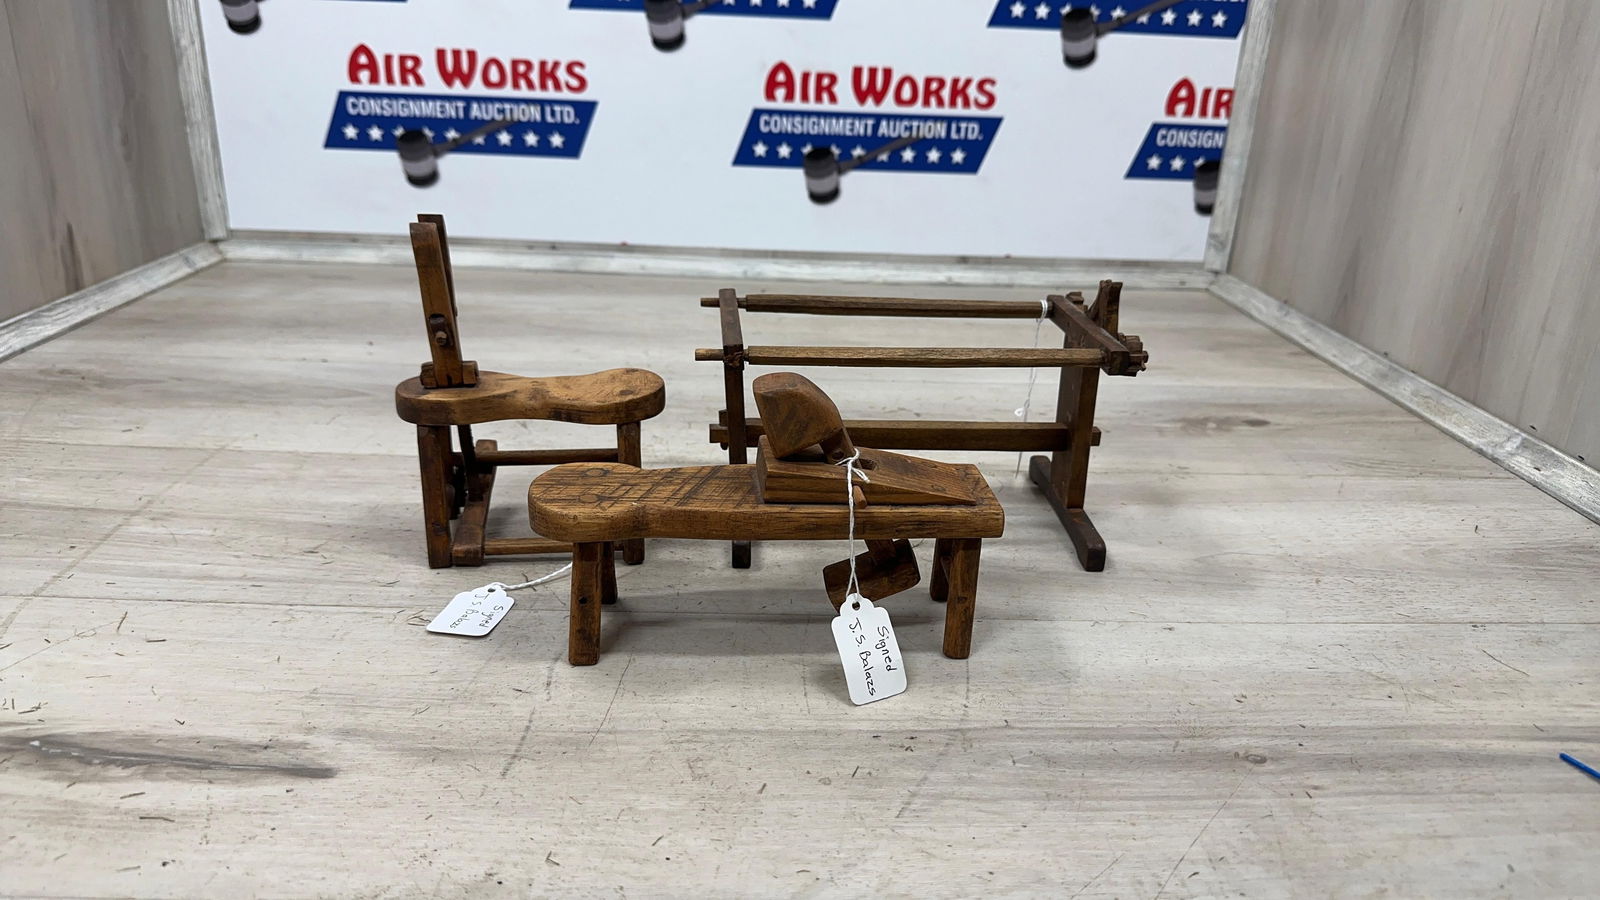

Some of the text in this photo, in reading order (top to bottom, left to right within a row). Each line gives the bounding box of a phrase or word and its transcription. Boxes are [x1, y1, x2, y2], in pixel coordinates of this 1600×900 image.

[348, 43, 588, 94] AIR WORKS
[764, 61, 997, 110] AIR WORKS
[346, 97, 580, 124] CONSIGNMENT AUCTION LTD.
[1165, 76, 1235, 119] AIR
[759, 114, 984, 140] CONSIGNMENT AUCTION LTD.
[874, 625, 898, 672] Signed
[859, 650, 877, 697] Balazs
